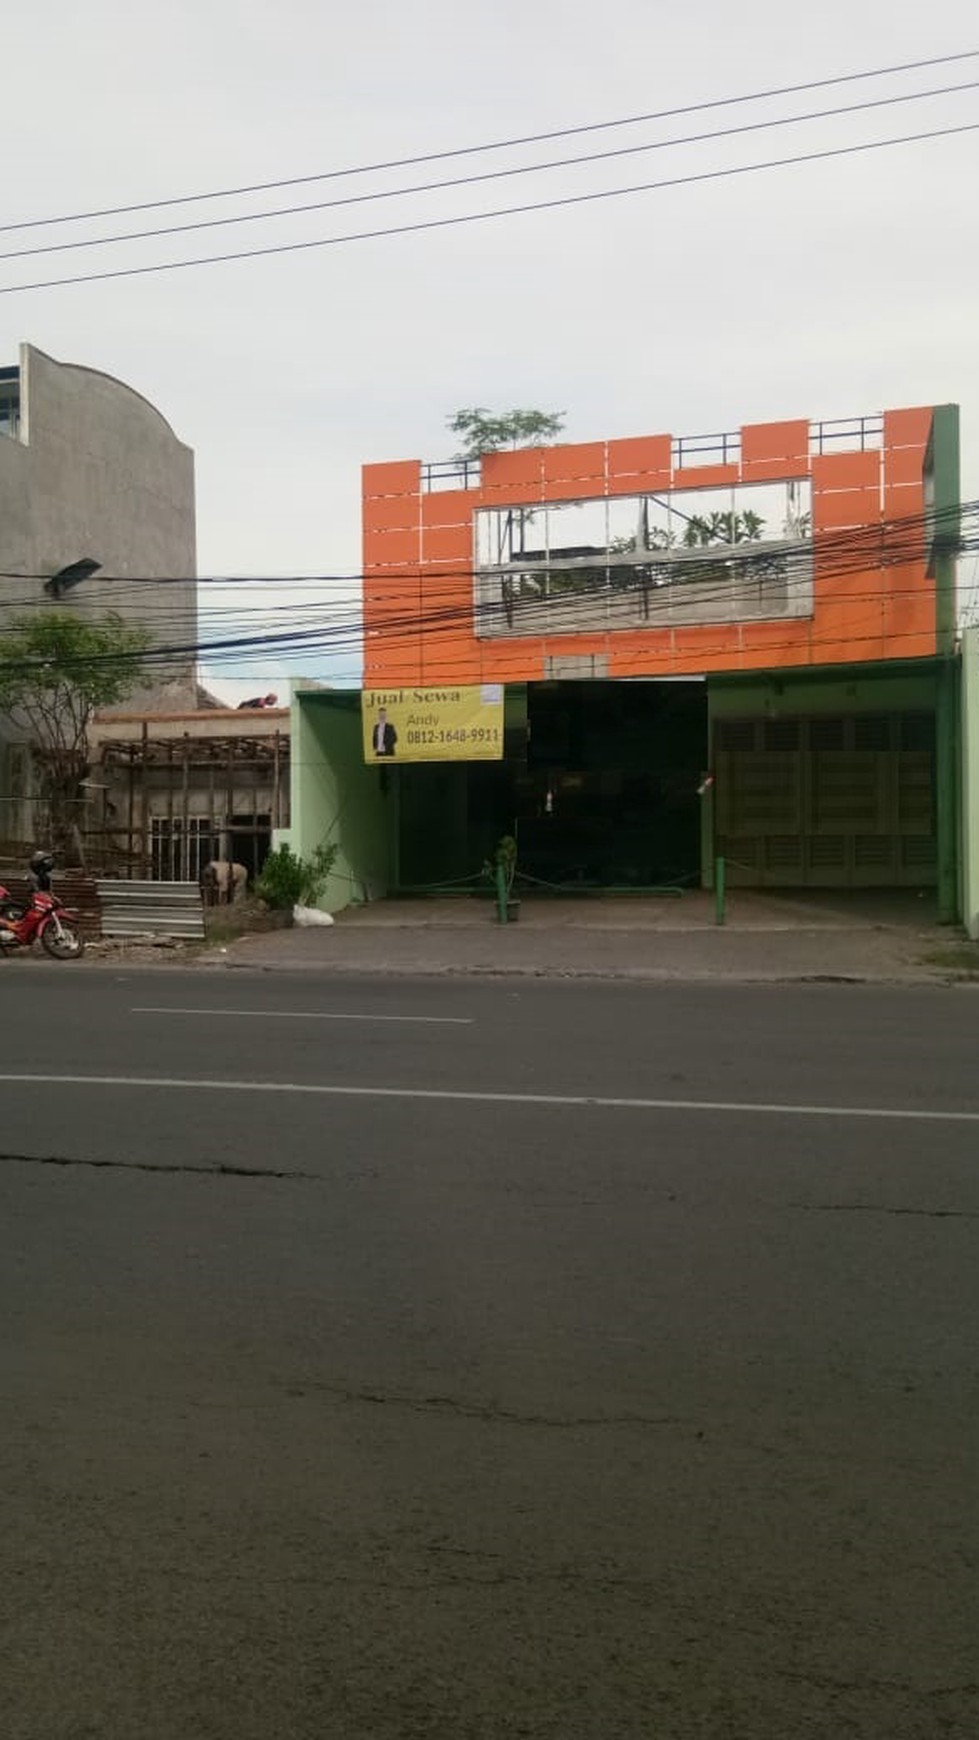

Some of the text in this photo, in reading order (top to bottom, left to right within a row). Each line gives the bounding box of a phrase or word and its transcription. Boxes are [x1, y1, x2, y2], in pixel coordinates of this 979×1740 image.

[366, 689, 460, 708] Jual Sewa
[406, 714, 439, 727] Andy
[407, 729, 498, 744] 0812-1648-9911
